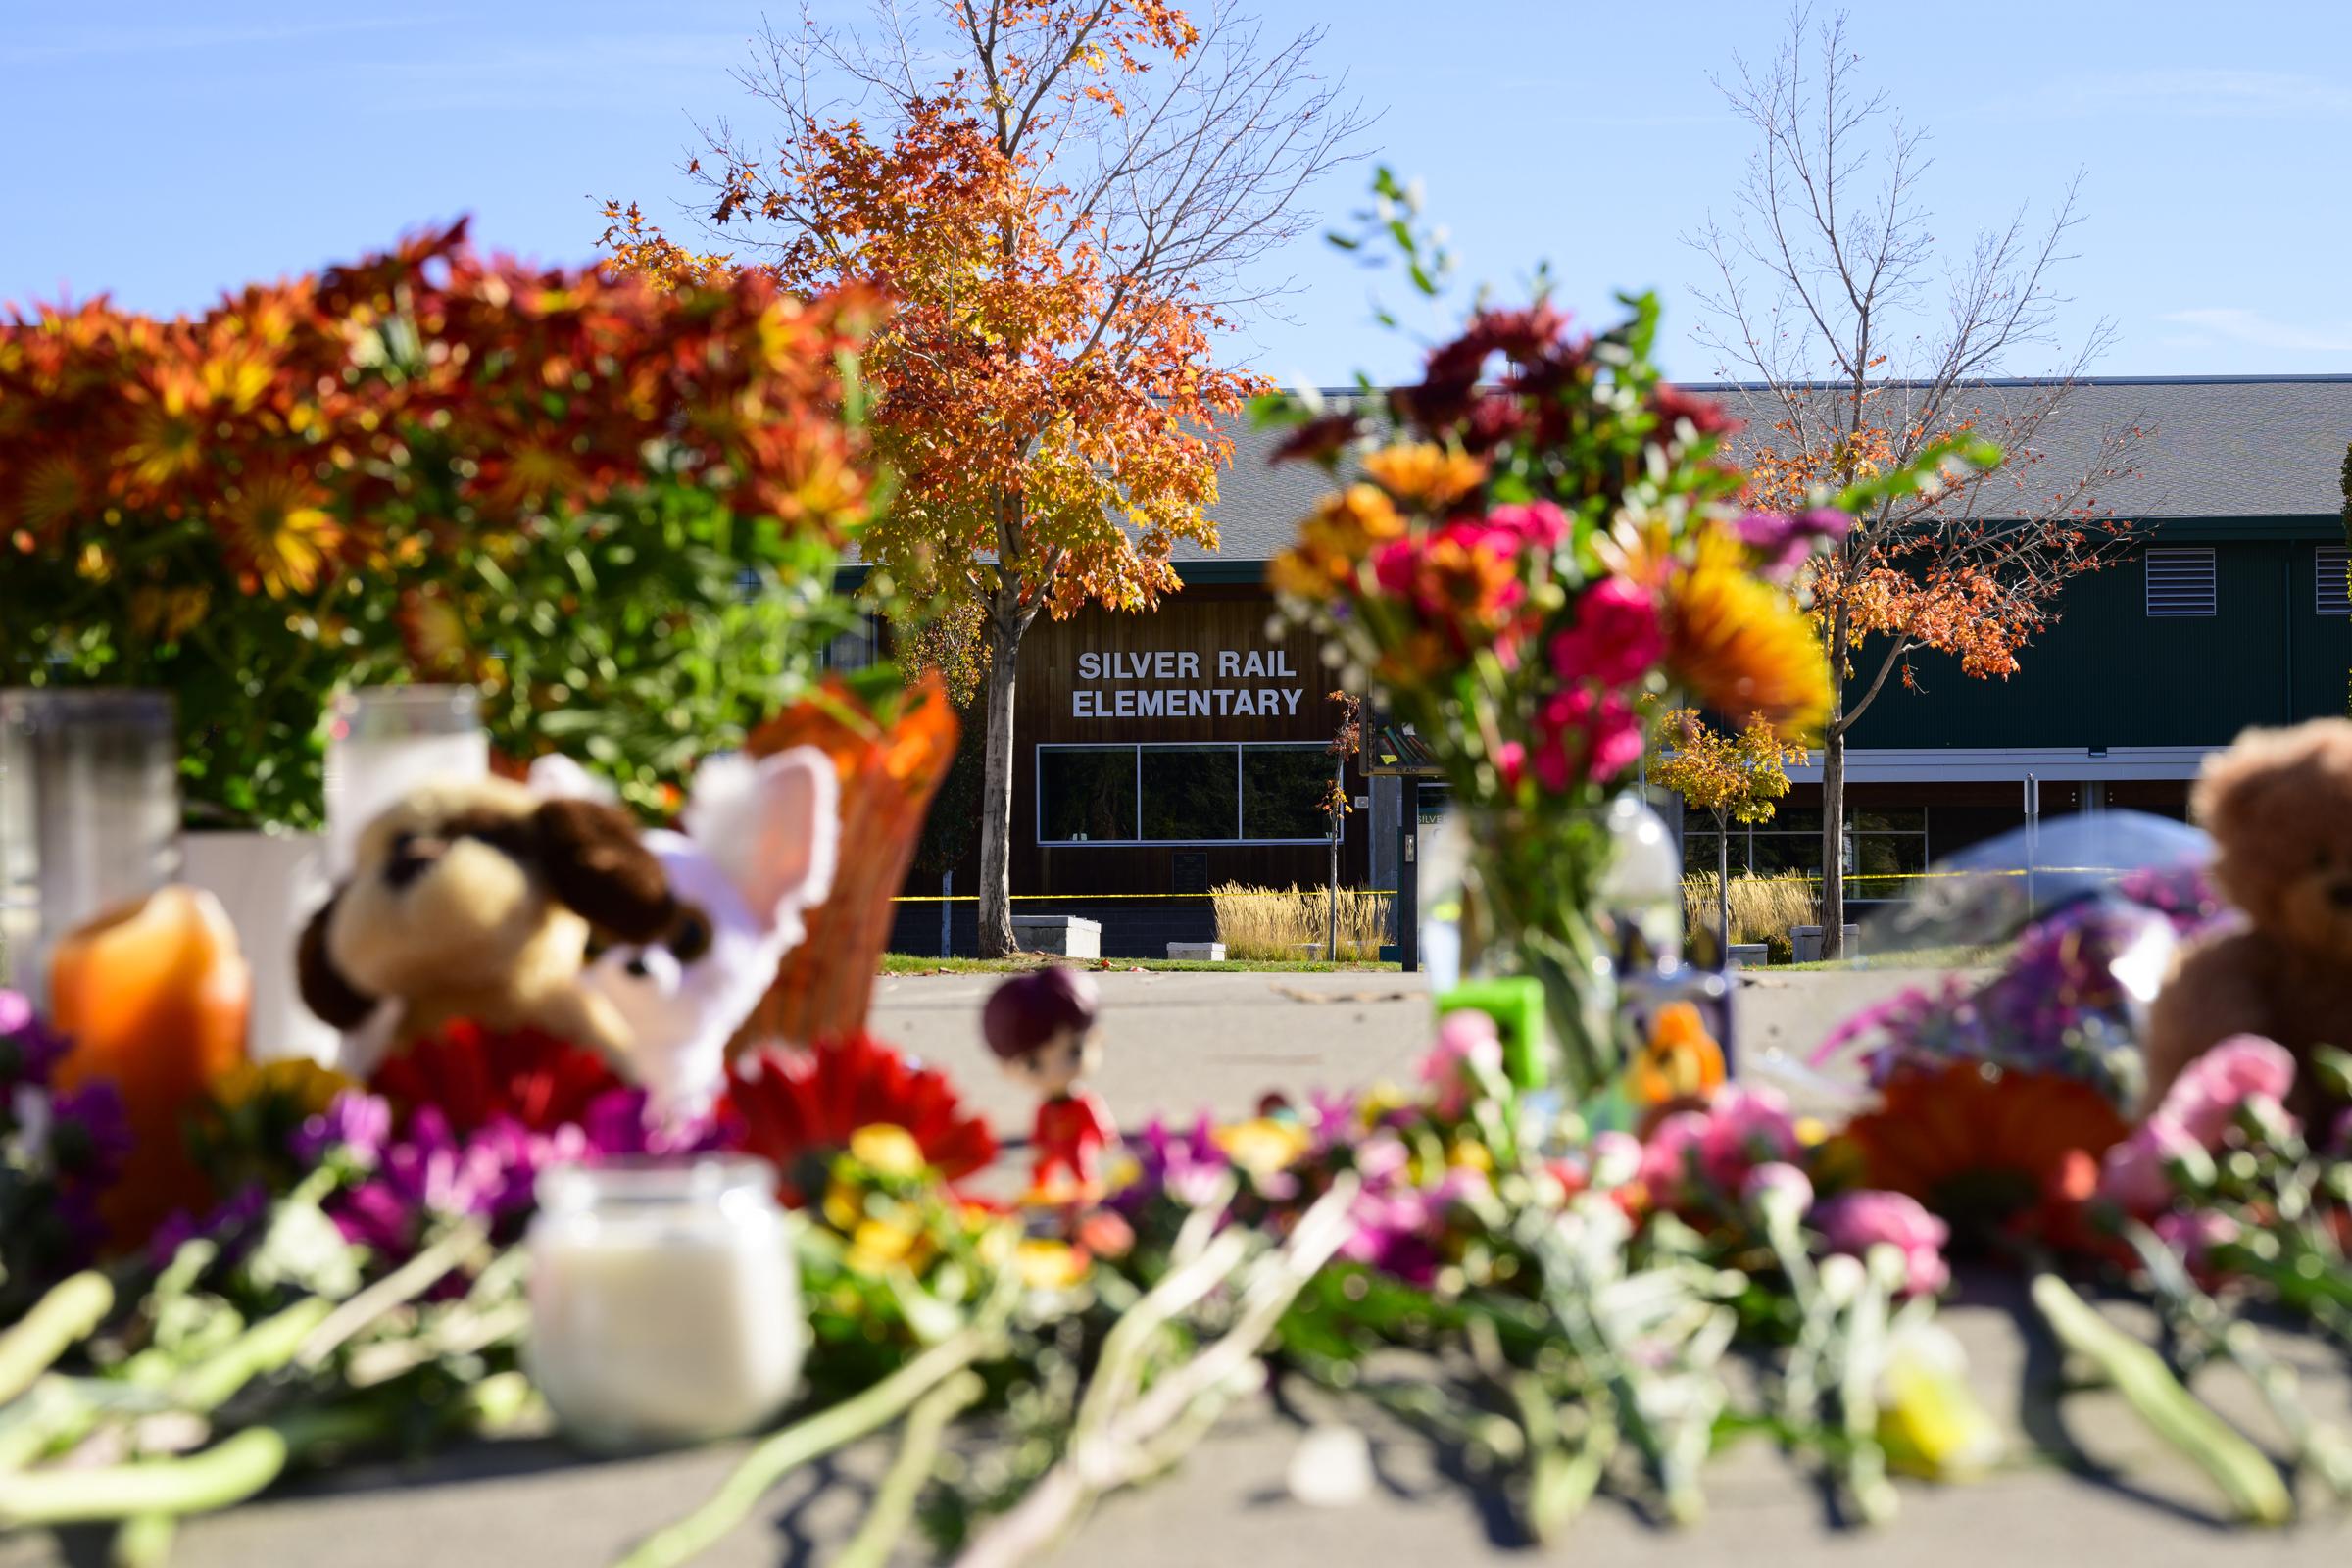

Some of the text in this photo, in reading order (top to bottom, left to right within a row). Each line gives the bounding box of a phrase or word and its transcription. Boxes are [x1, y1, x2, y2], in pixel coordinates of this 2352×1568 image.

[1078, 650, 1297, 679] SILVER RAIL
[1072, 688, 1303, 717] ELEMENTARY
